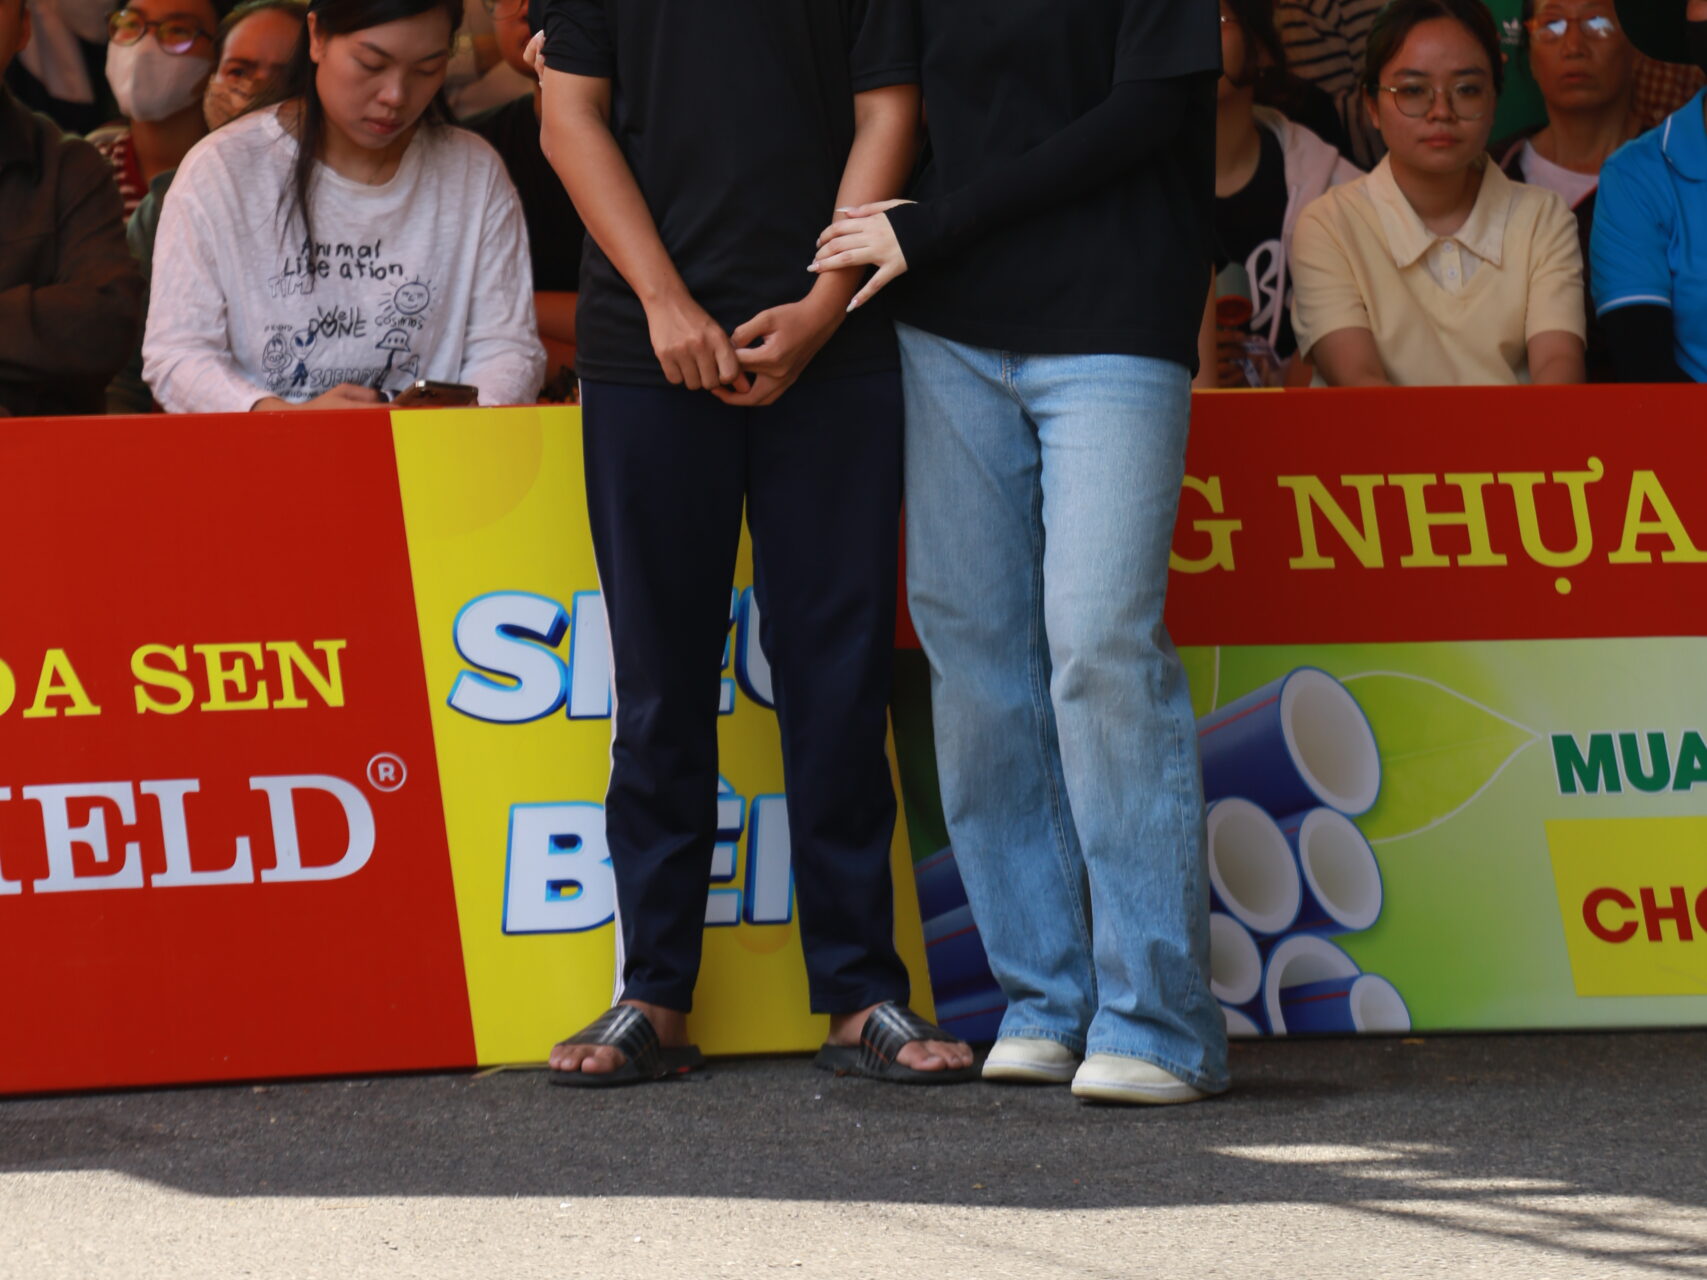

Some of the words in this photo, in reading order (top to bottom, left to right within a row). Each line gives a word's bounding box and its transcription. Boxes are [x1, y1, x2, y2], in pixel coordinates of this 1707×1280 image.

[1277, 456, 1707, 595] NHỰA
[0, 647, 101, 719] A
[130, 639, 347, 715] SEN
[1582, 885, 1707, 944] CH
